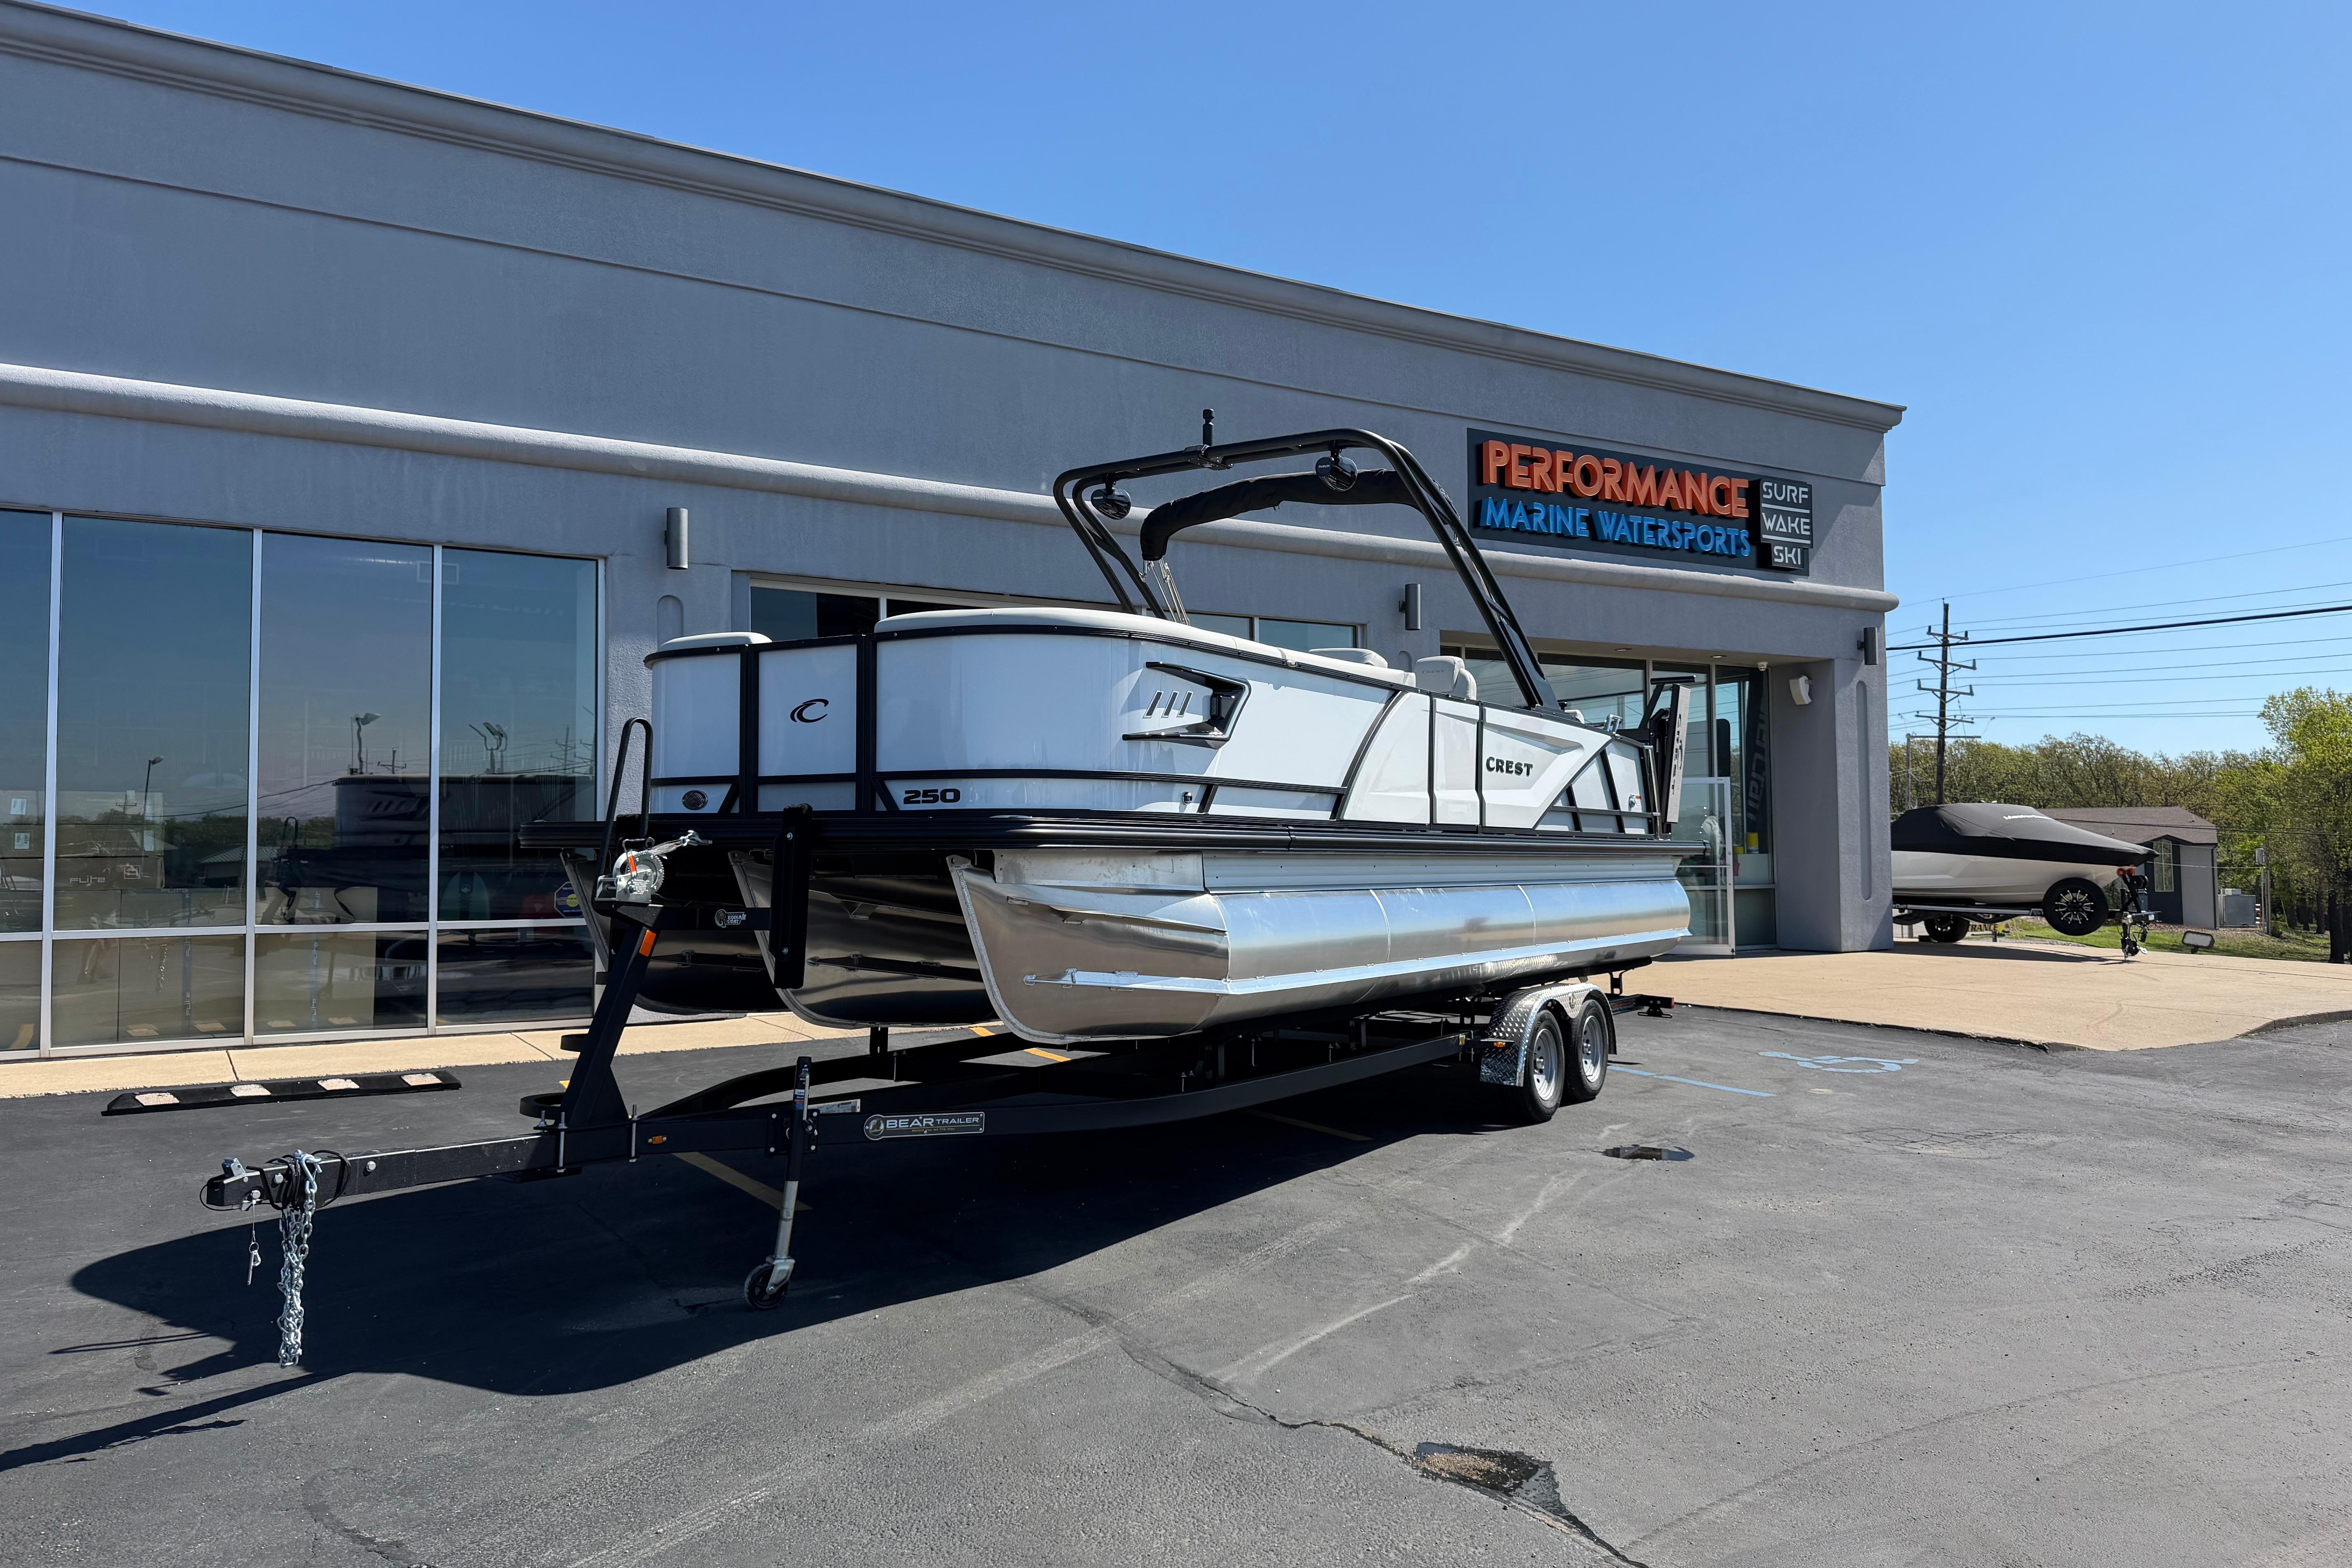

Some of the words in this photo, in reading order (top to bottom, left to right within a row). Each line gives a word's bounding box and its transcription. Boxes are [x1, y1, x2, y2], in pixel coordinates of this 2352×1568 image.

[1483, 440, 1749, 518] PERFORMANCE
[1762, 482, 1808, 504] SURF
[1480, 496, 1590, 537] MARINE
[1592, 510, 1751, 557] WATERSPORTS
[1762, 513, 1811, 536] WAKE
[1773, 546, 1801, 566] SKI
[1486, 756, 1533, 777] CREST
[903, 788, 961, 805] 250
[886, 1118, 934, 1129] BEAR
